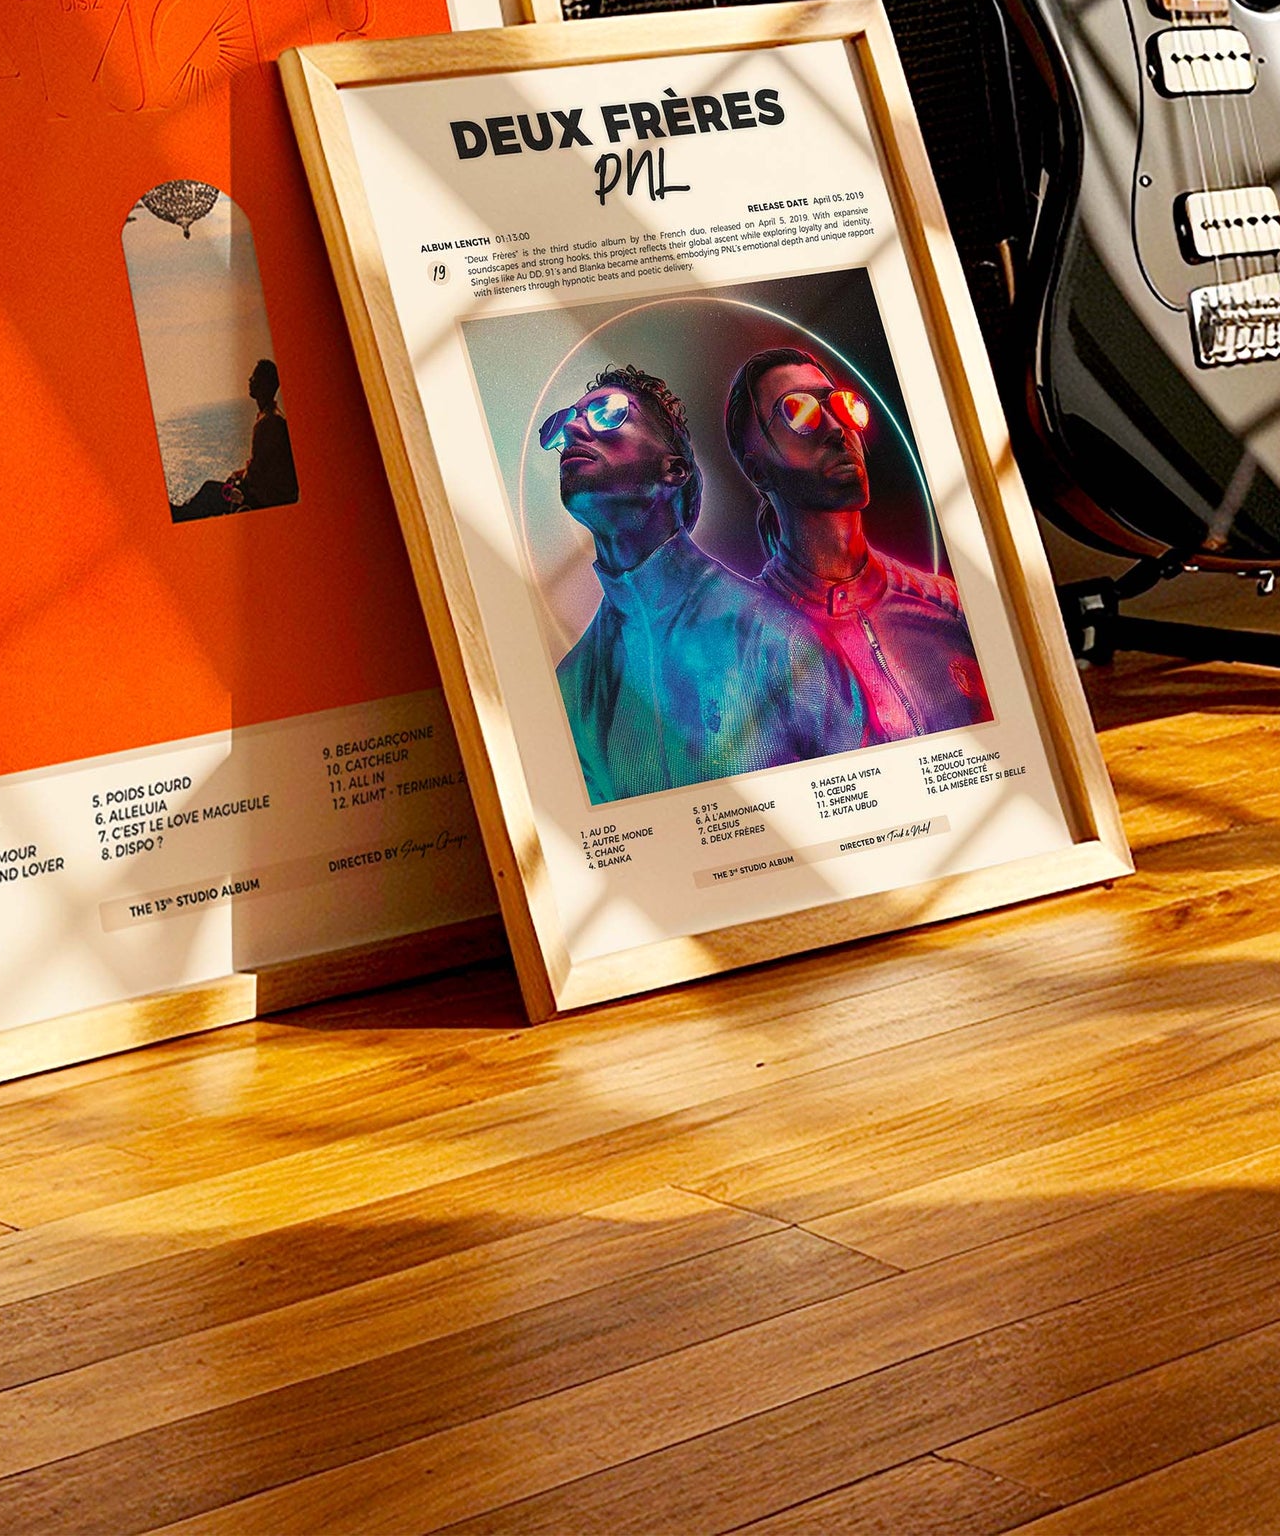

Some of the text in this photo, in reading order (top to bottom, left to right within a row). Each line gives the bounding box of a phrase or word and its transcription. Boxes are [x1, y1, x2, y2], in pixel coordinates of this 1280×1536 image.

[450, 88, 784, 159] DEUX FRÈRES
[594, 148, 690, 206] PNL
[747, 191, 864, 213] RELEASE DATE April 05, 2019
[420, 231, 530, 253] ALBUM LENGTH 01:13:00
[434, 265, 445, 281] 19
[473, 287, 492, 297] with
[493, 284, 527, 295] listeners
[527, 278, 560, 291] through
[561, 274, 596, 287] hypnotic
[597, 272, 619, 281] beats
[620, 268, 636, 278] and
[637, 265, 661, 278] poetic
[918, 748, 963, 765] 13. MENACE
[921, 751, 1000, 775] 14. ZOULOU TCHAING
[923, 762, 988, 785] 15. DÉCONNECTÉ
[926, 766, 1026, 795] 16. LA MISÈRE EST SI BELLE
[92, 776, 192, 808] 5. POIDS LOURD
[94, 799, 168, 825] 6. ALLELUIA
[97, 795, 269, 843] 7. C'EST LE LOVE MAGUEULE
[101, 835, 163, 861] 8. DISPO ?
[22, 857, 64, 878] LOVER
[128, 878, 260, 917] THE 13th STUDIO ALBUM
